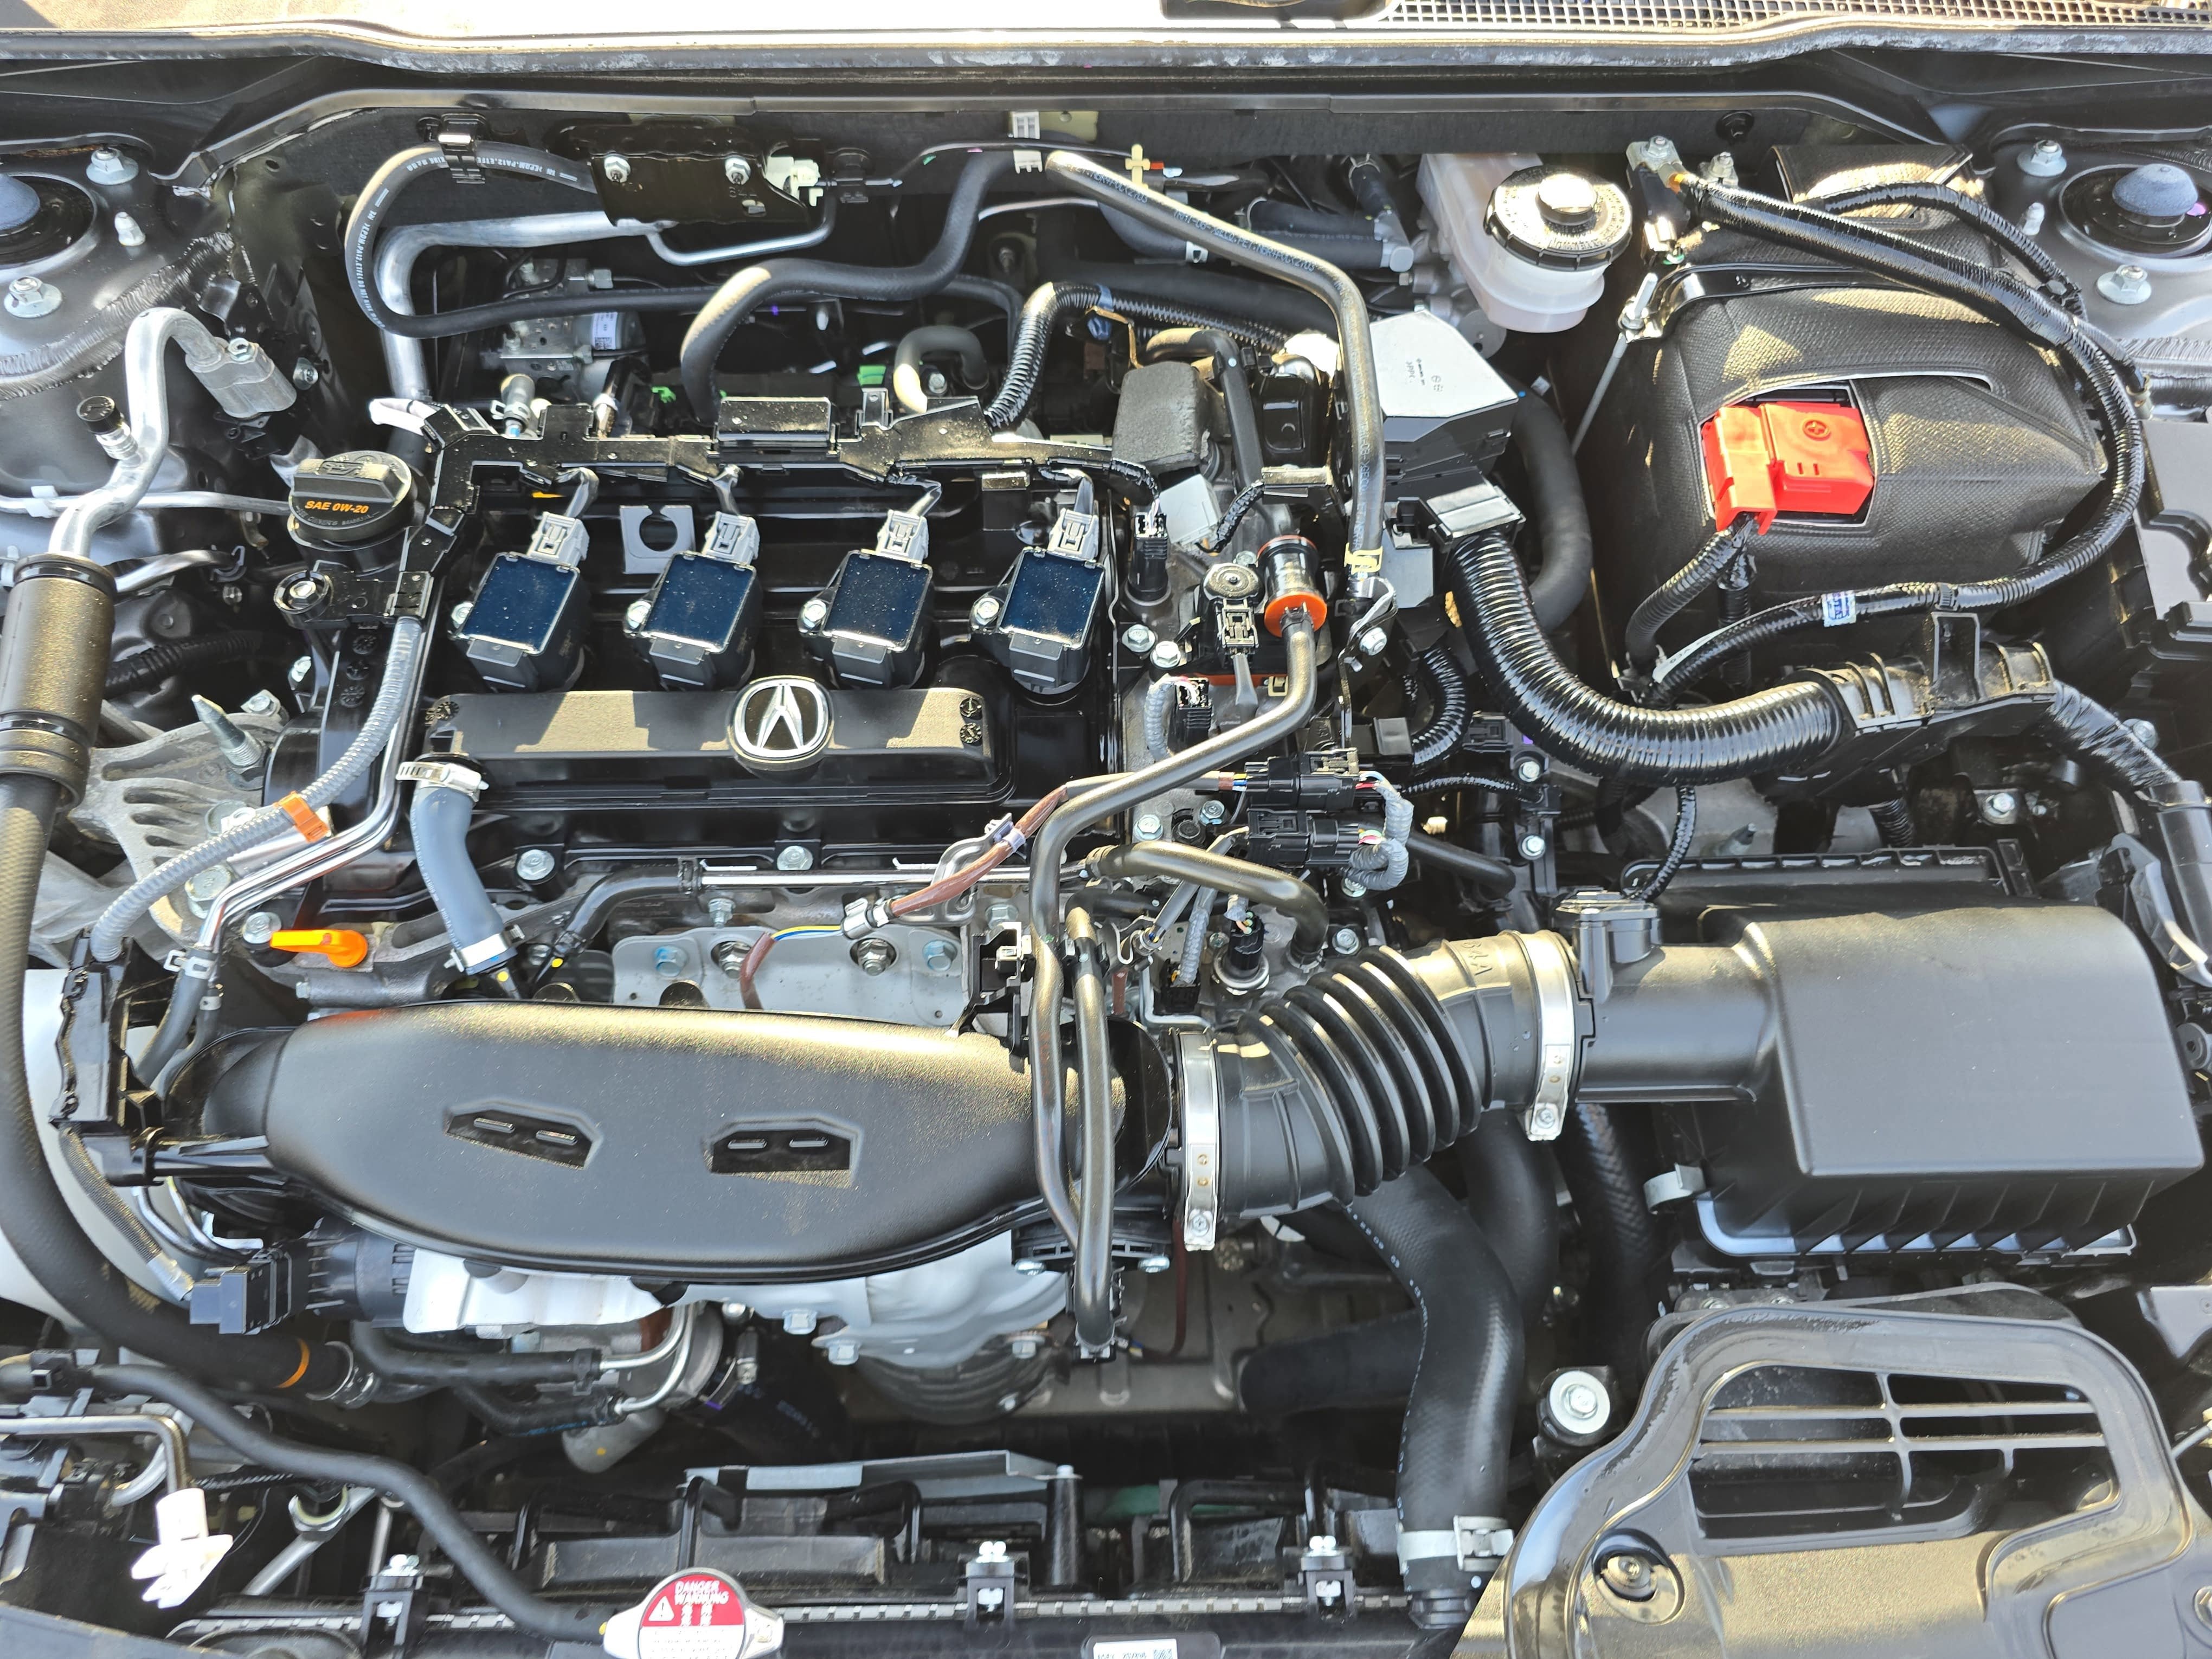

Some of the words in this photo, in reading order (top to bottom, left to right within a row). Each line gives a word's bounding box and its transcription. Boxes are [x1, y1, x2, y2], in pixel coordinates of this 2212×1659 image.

[304, 500, 332, 510] SAE
[332, 503, 370, 513] 0W-20
[674, 1580, 721, 1596] DANGER
[674, 1590, 730, 1605] WARNING
